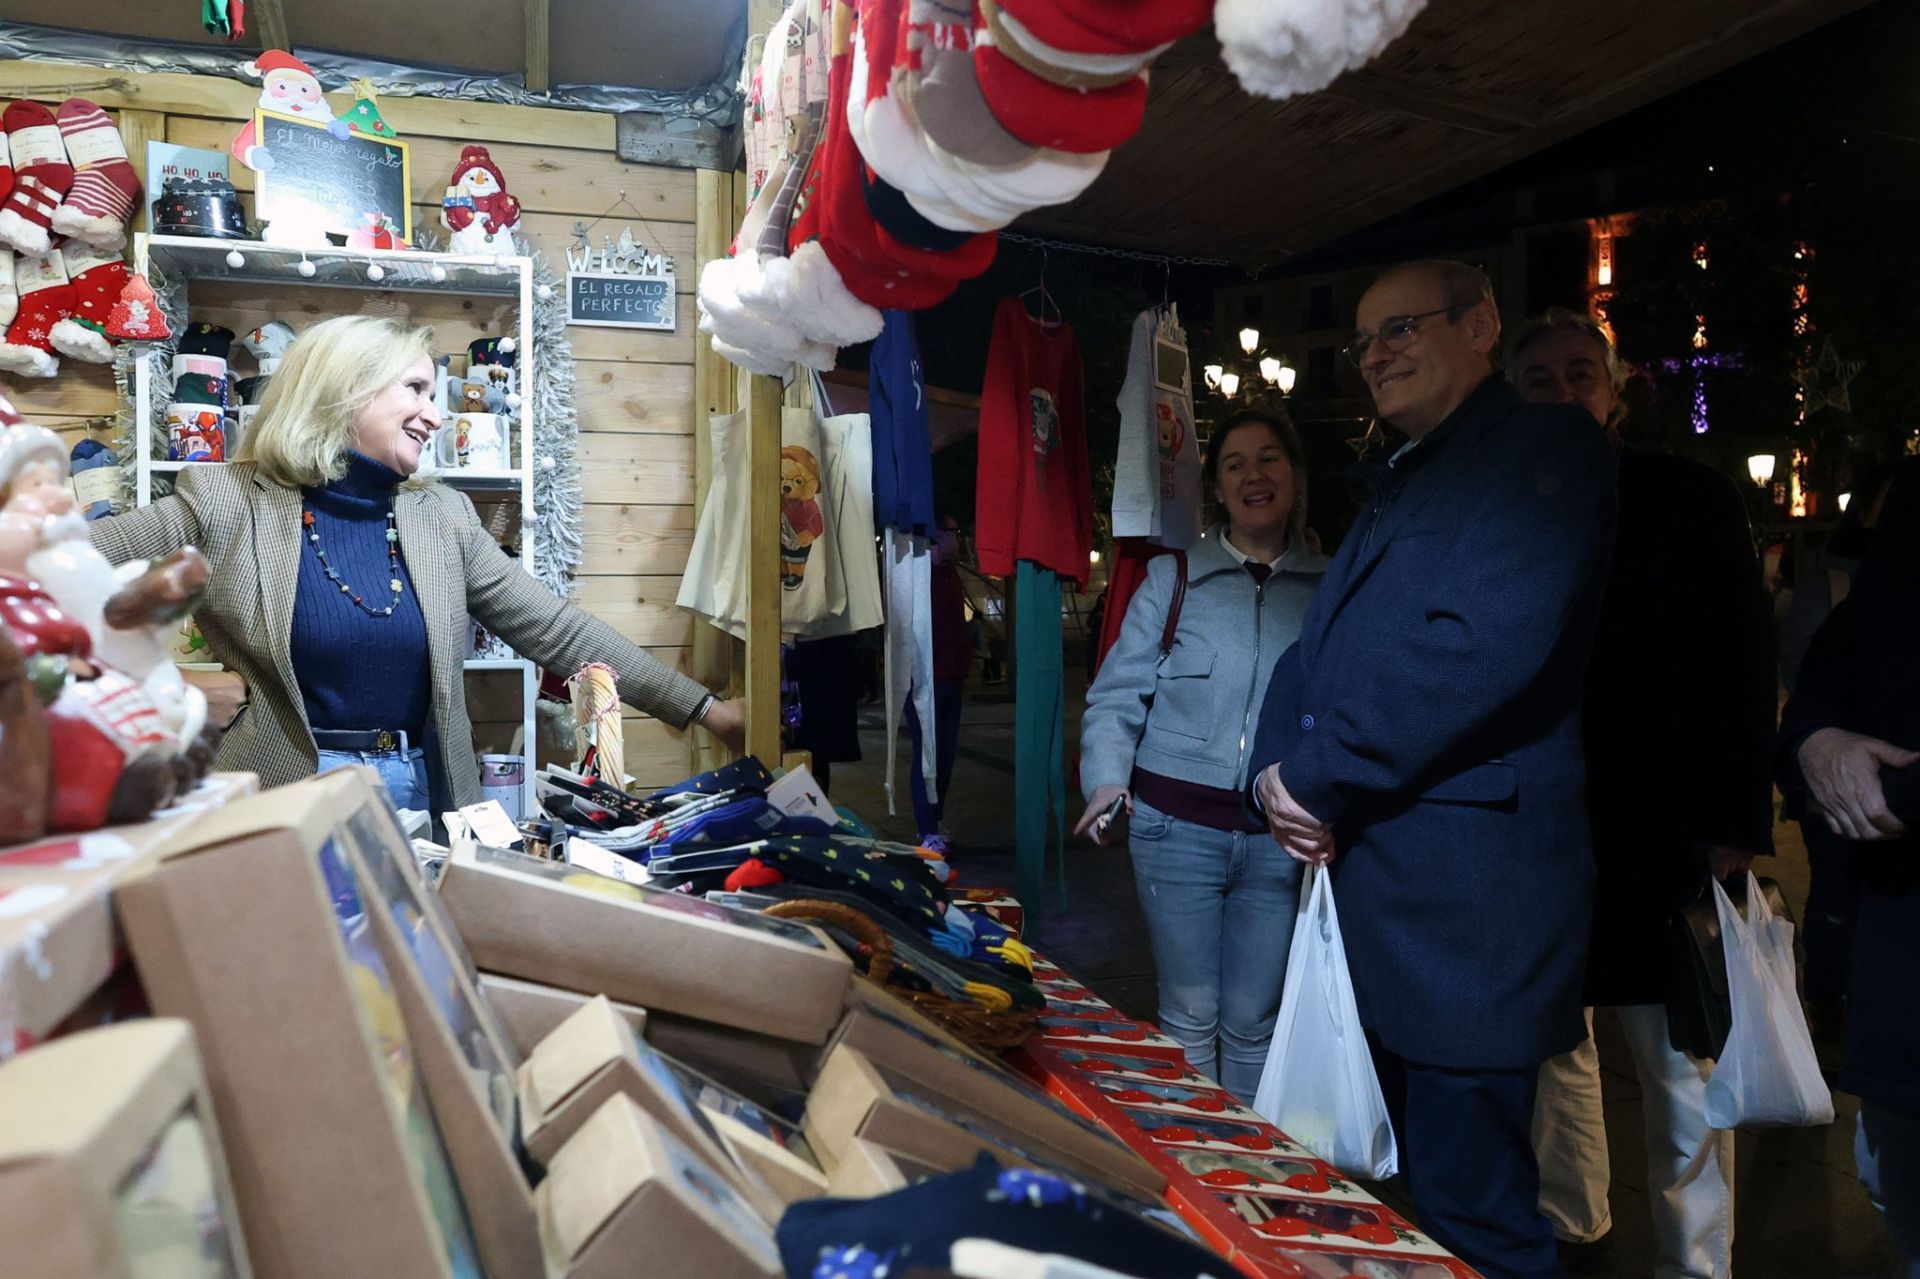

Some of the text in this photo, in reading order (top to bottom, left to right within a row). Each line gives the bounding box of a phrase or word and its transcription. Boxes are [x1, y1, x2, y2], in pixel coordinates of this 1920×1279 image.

[357, 148, 402, 171] regalo
[162, 165, 178, 175] HO
[184, 168, 200, 178] HO
[566, 246, 674, 275] WELCOME
[578, 280, 662, 296] EL REGALO
